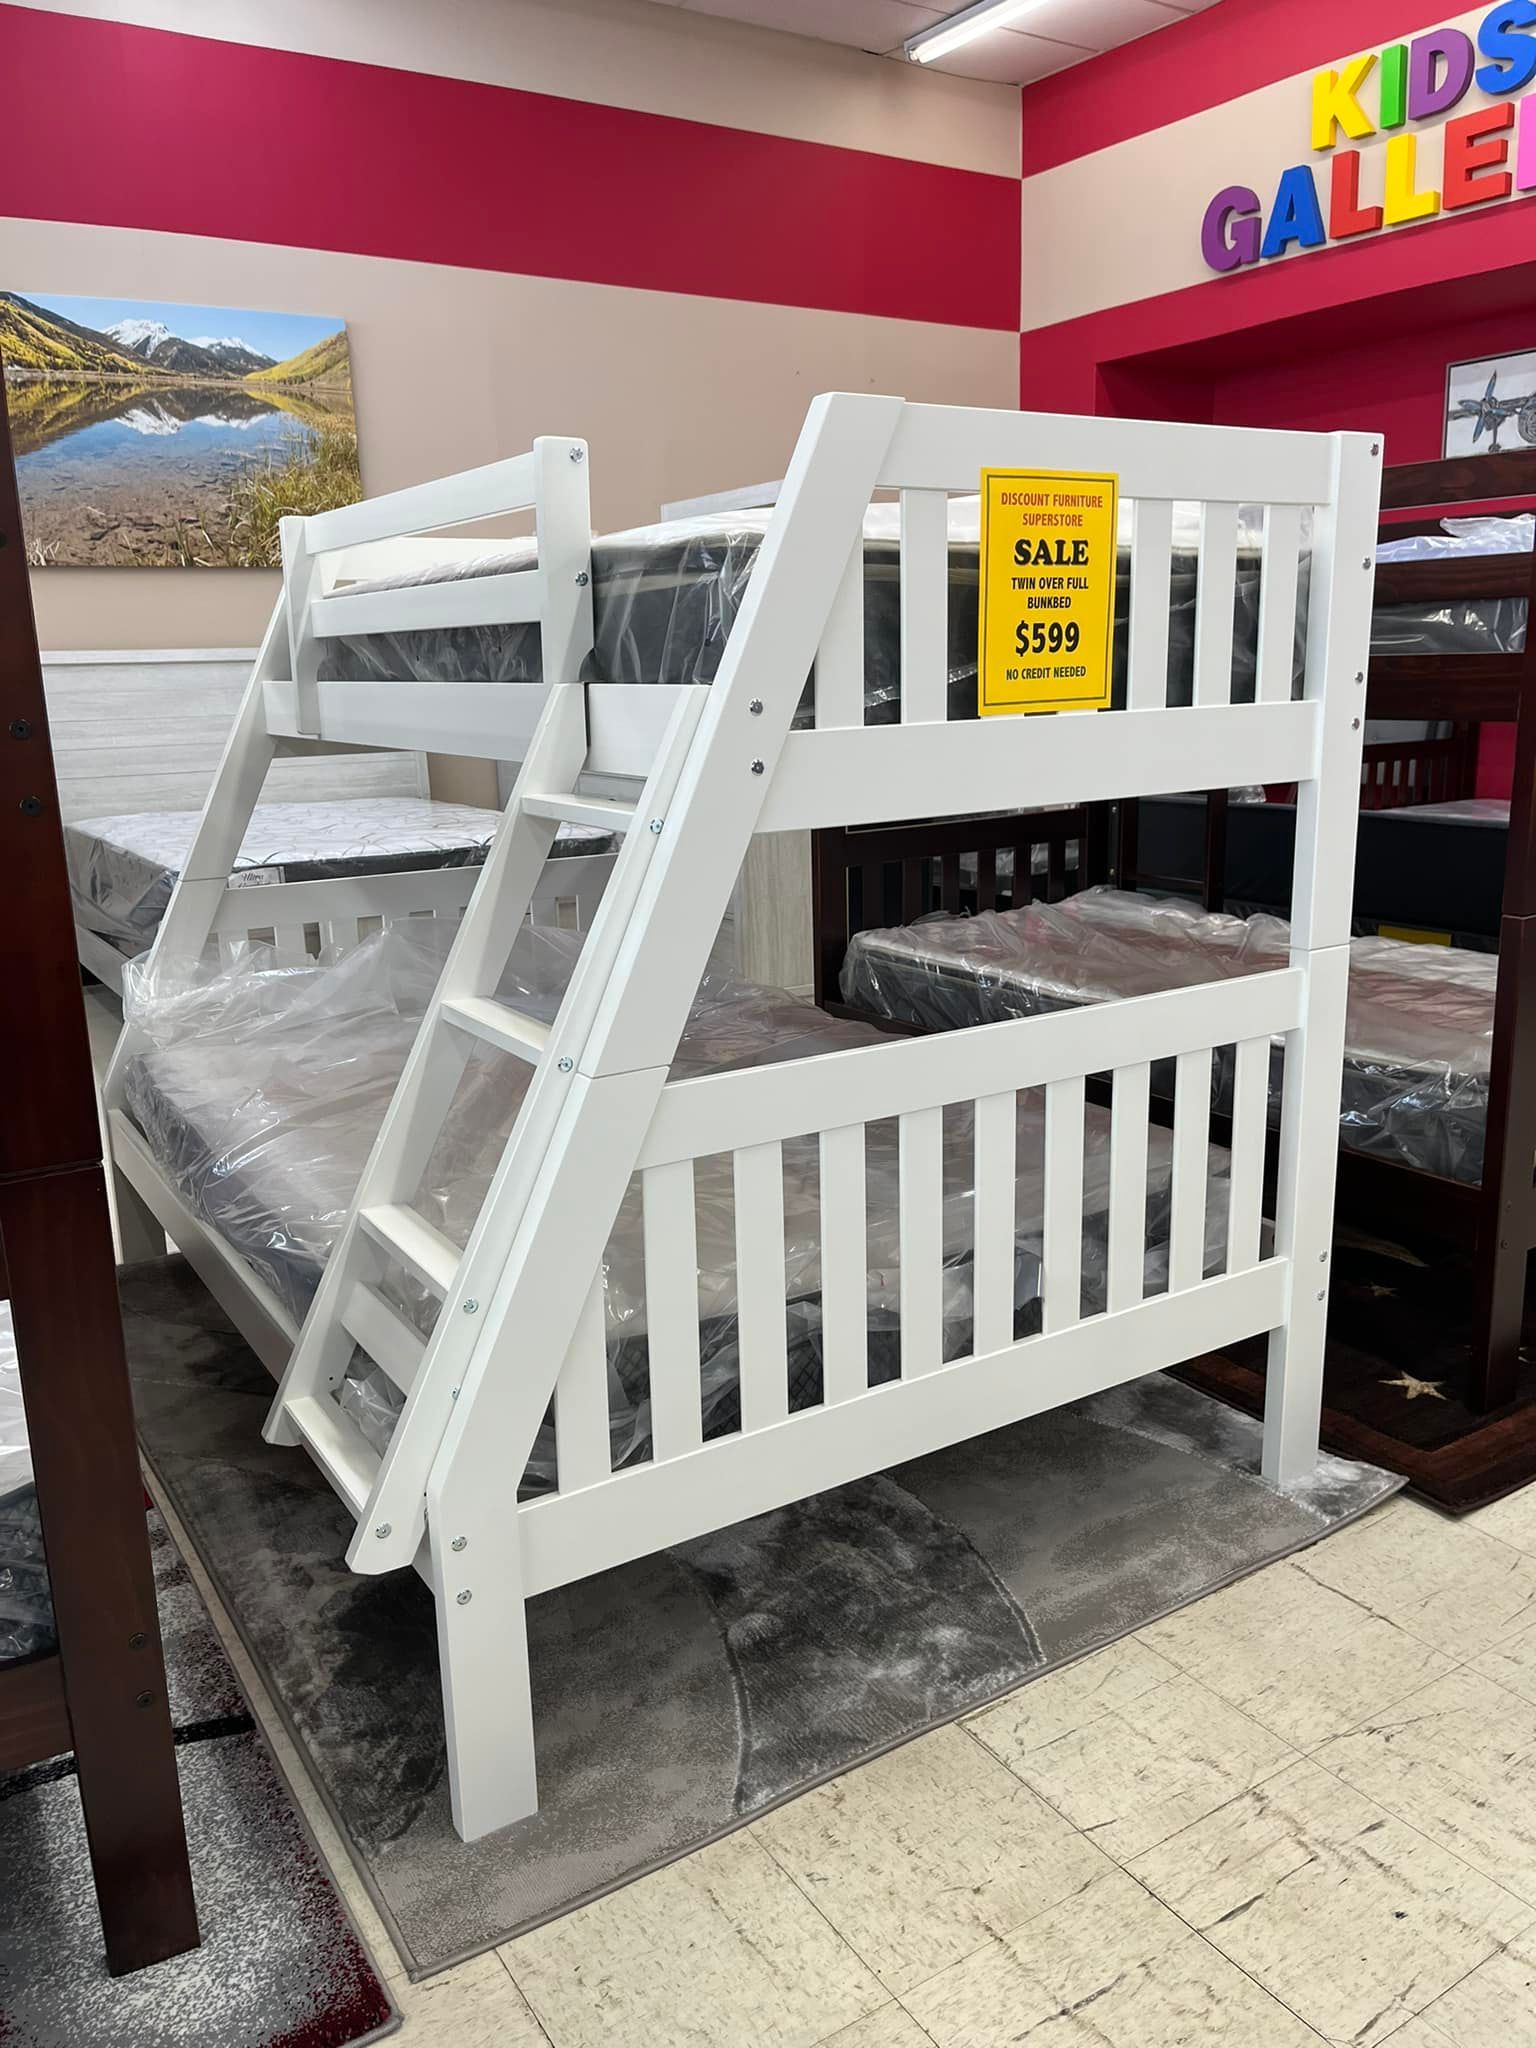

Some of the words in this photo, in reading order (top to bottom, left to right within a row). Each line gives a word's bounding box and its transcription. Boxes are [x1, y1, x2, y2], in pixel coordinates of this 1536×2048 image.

[1312, 0, 1536, 151] KIDS
[1201, 94, 1536, 272] GALLE
[1001, 492, 1050, 506] DISCOUNT
[1053, 494, 1103, 508] FURNITURE
[1022, 513, 1083, 527] SUPERSTORE
[1014, 538, 1089, 566] SALE
[1011, 577, 1036, 590] TWIN
[1039, 577, 1064, 589] OVER
[1067, 577, 1088, 589] FULL
[1027, 596, 1071, 609] BUNKBED
[1015, 620, 1080, 657] $599
[1006, 669, 1019, 681] NO
[1021, 667, 1051, 680] CREDIT
[1053, 666, 1087, 678] NEEDED
